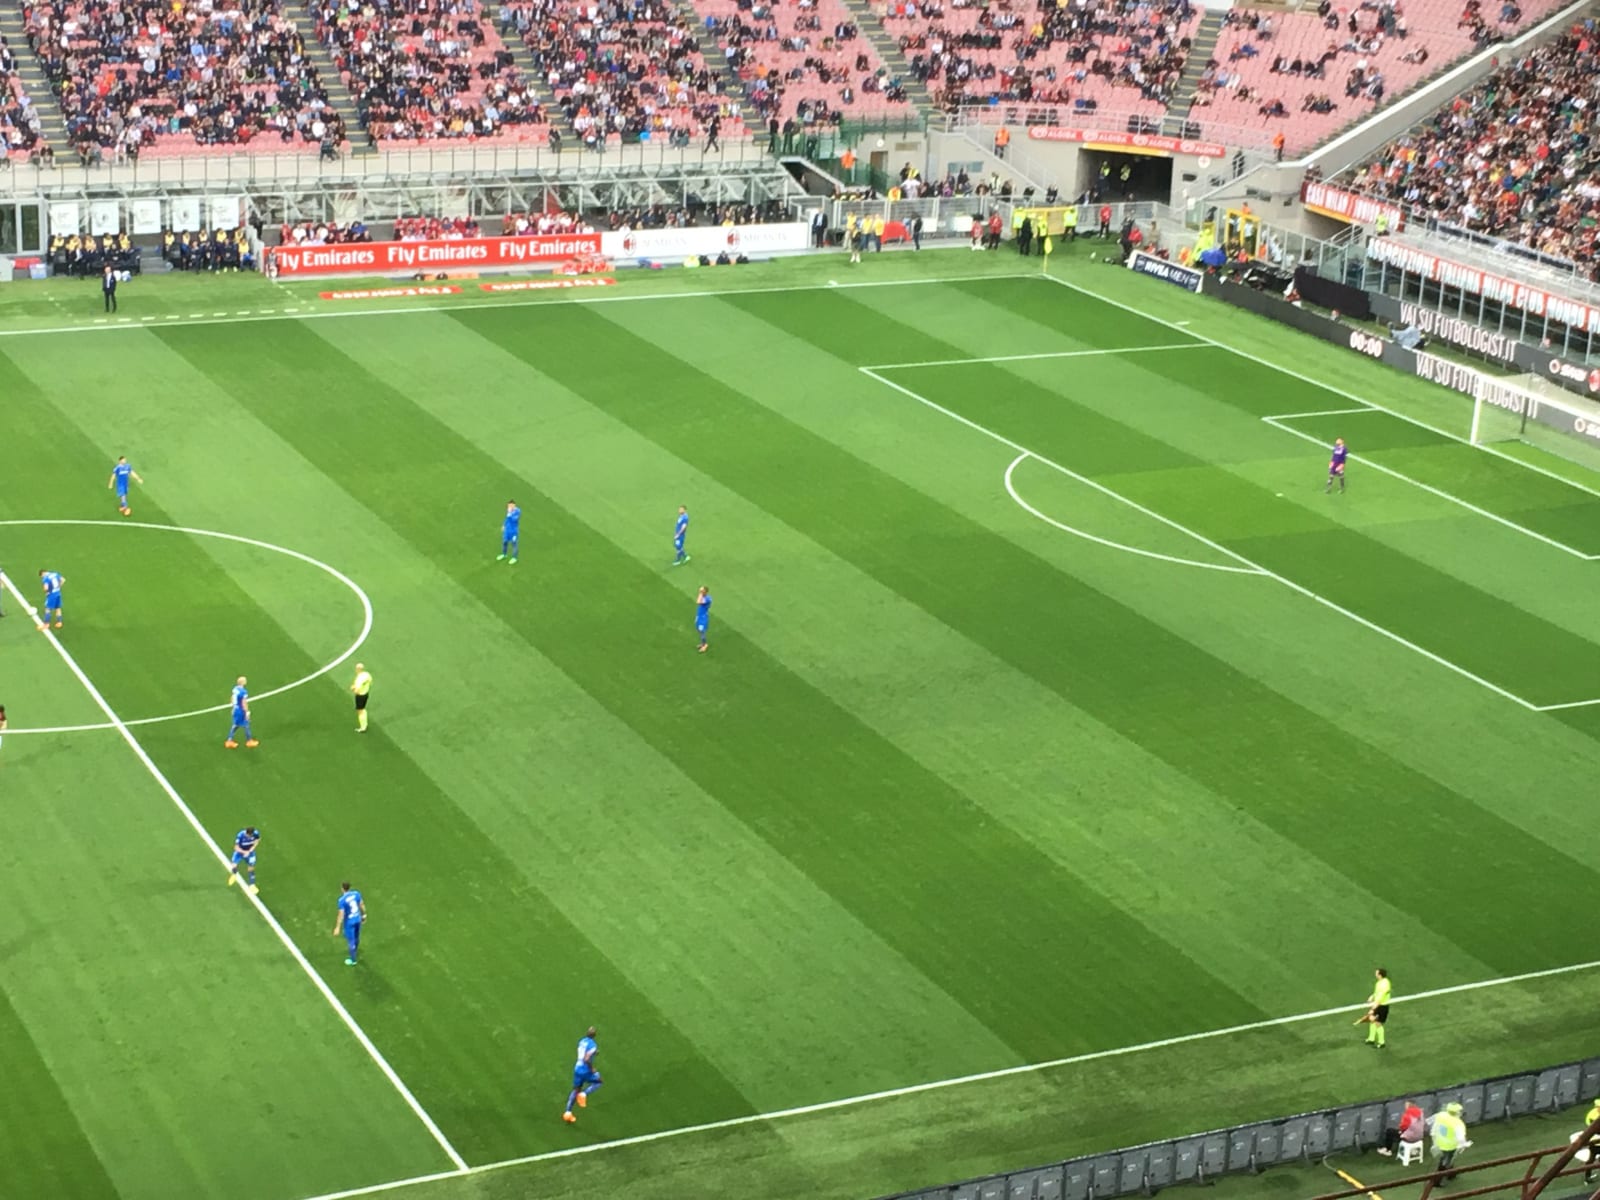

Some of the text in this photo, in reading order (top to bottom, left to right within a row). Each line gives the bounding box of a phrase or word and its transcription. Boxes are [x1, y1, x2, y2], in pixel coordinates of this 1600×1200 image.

[303, 249, 375, 267] Emirates
[388, 246, 415, 265] Fly
[418, 244, 487, 261] Emirates
[500, 241, 527, 259] Fly
[530, 237, 597, 256] Emirates
[1144, 261, 1189, 284] NIVEA MEN
[1482, 274, 1515, 305] MILAN
[1516, 286, 1545, 314] CLUB
[1349, 331, 1384, 358] 00:00
[1400, 302, 1518, 362] VAI SU FUTBOLOGIST.IT
[1415, 352, 1433, 379] VAI
[1434, 359, 1451, 386] SU
[1451, 365, 1538, 419] FUTBOLOGISTIT
